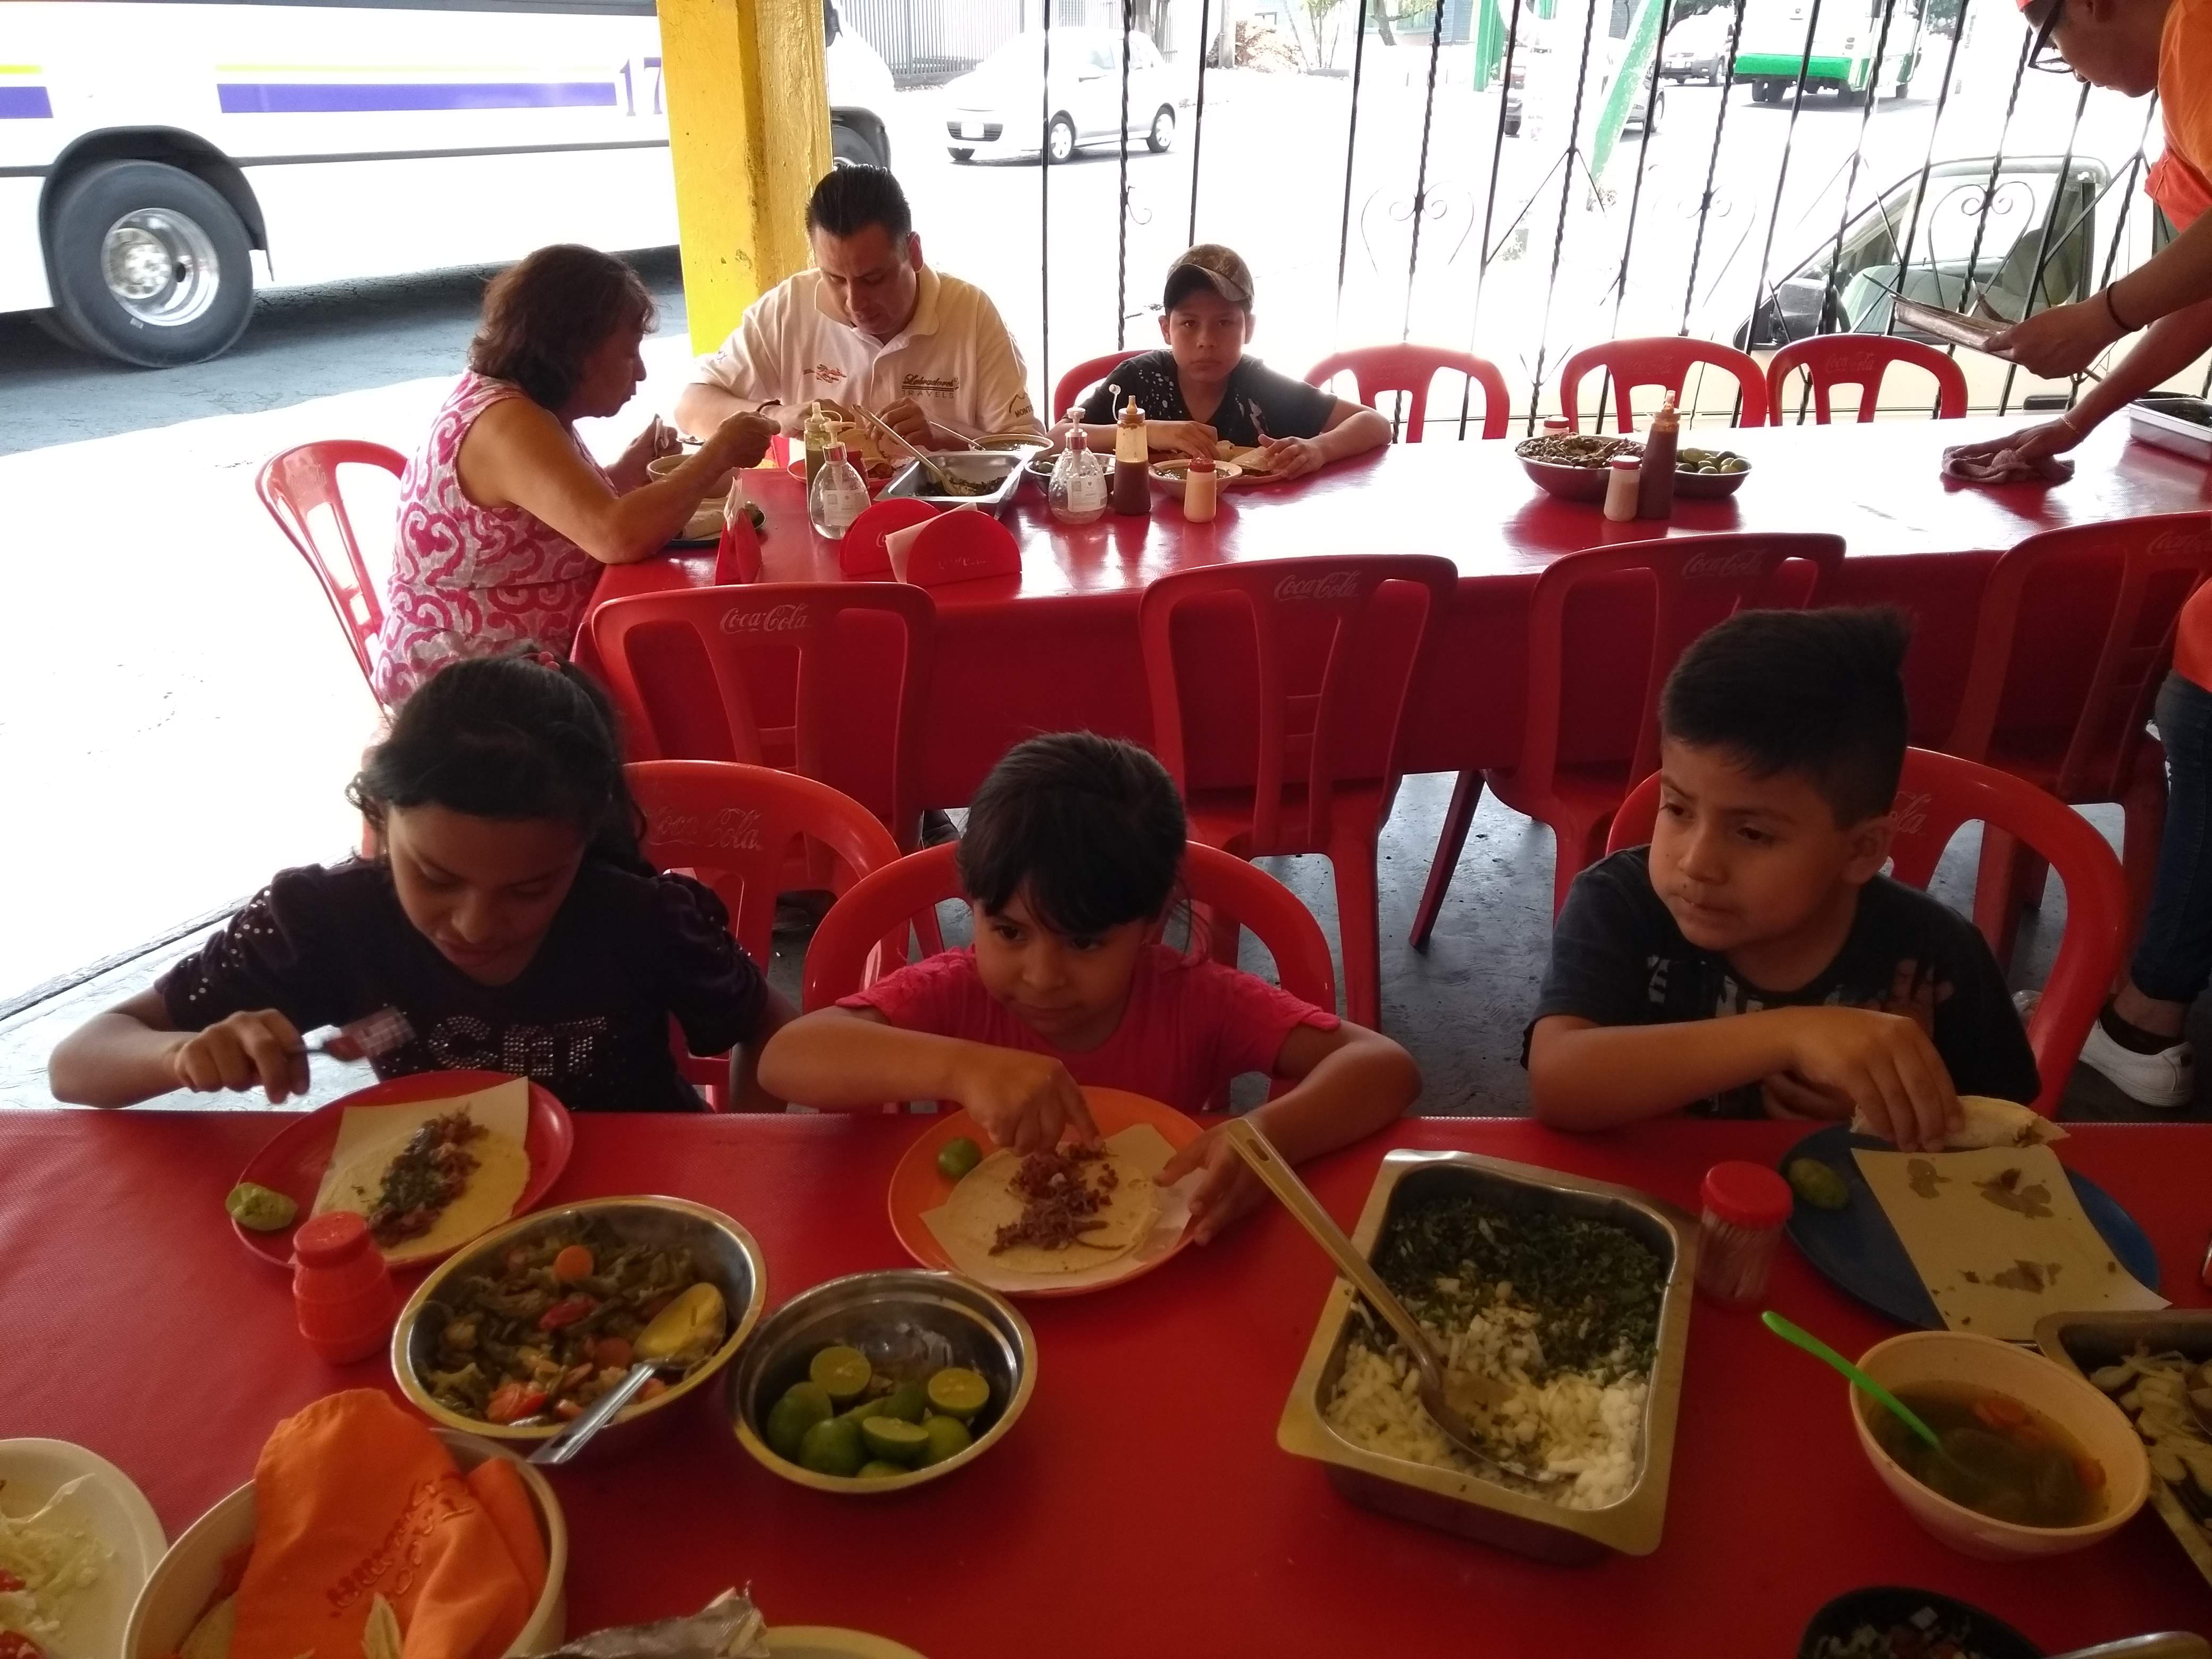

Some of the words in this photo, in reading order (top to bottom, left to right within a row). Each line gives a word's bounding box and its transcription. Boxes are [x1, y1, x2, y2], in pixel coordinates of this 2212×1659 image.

[902, 390, 954, 398] TRAVELS
[1273, 571, 1361, 603] Coca-Cola
[719, 604, 809, 635] Coca-Cola
[647, 807, 761, 850] CocaCola
